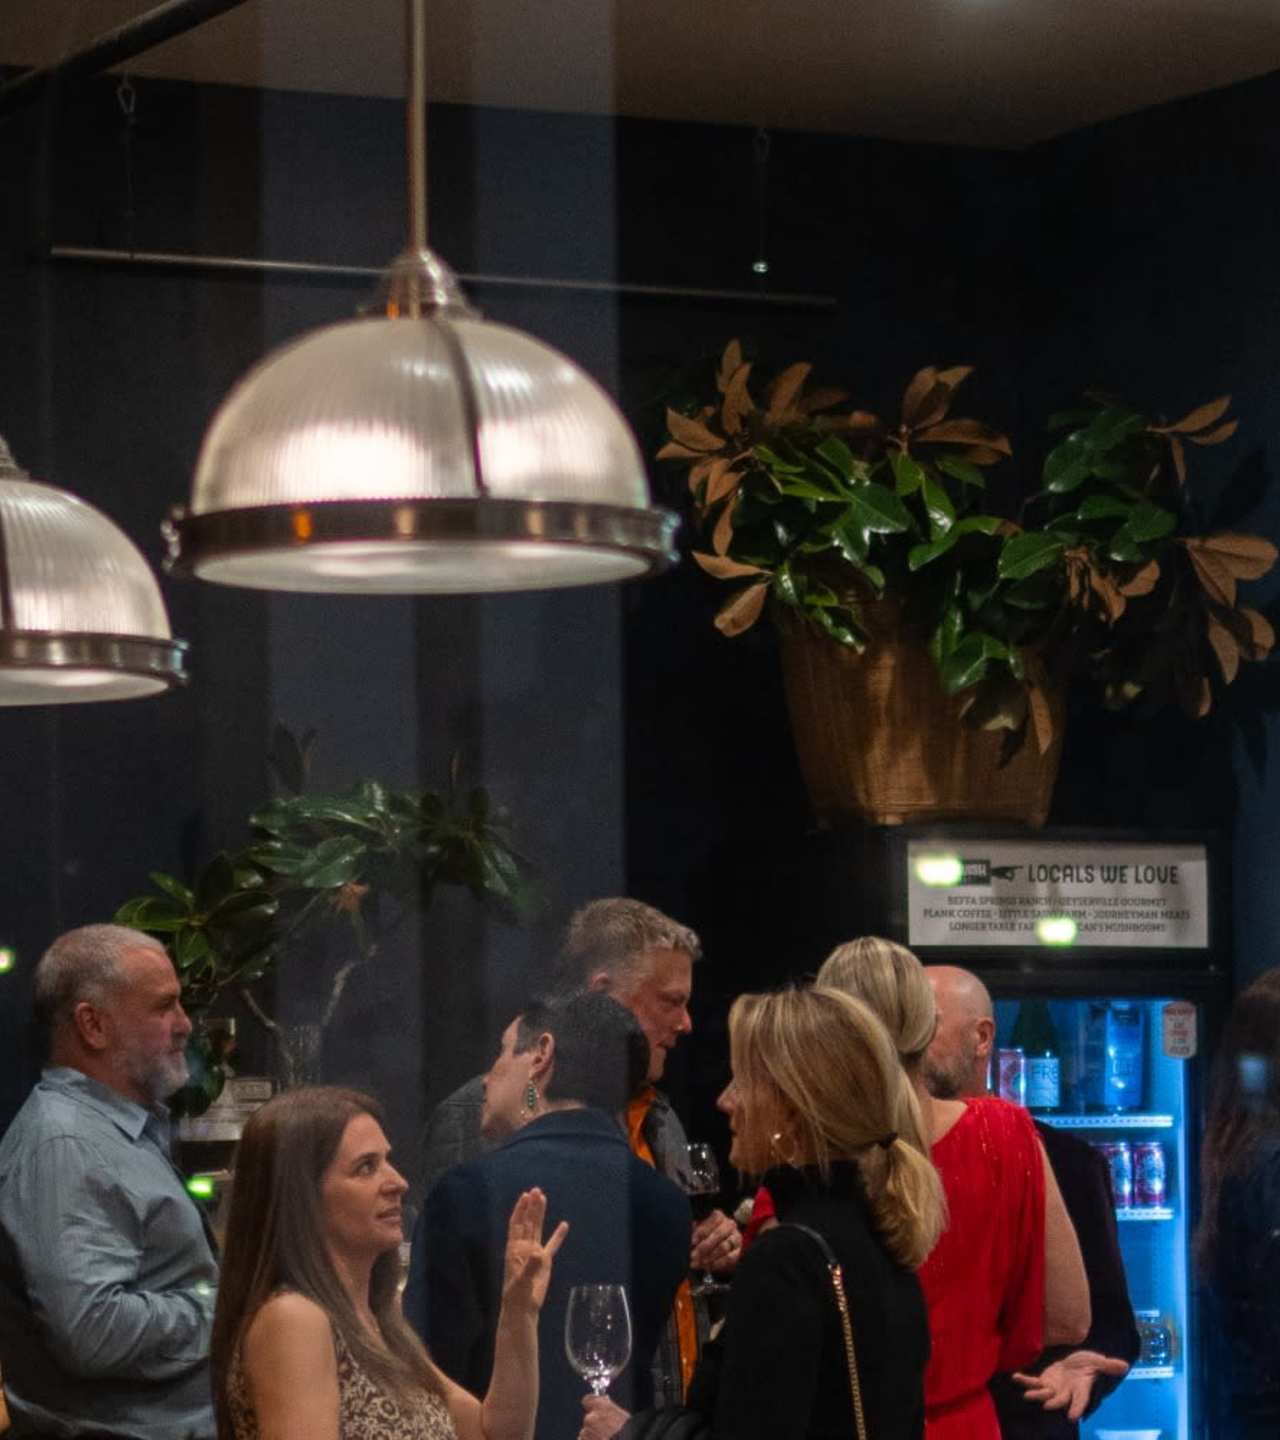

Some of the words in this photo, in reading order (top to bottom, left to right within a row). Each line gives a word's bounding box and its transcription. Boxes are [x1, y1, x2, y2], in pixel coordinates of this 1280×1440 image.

[1027, 863, 1095, 883] LOCALS
[1100, 864, 1129, 885] WE
[1135, 864, 1179, 885] LOVE
